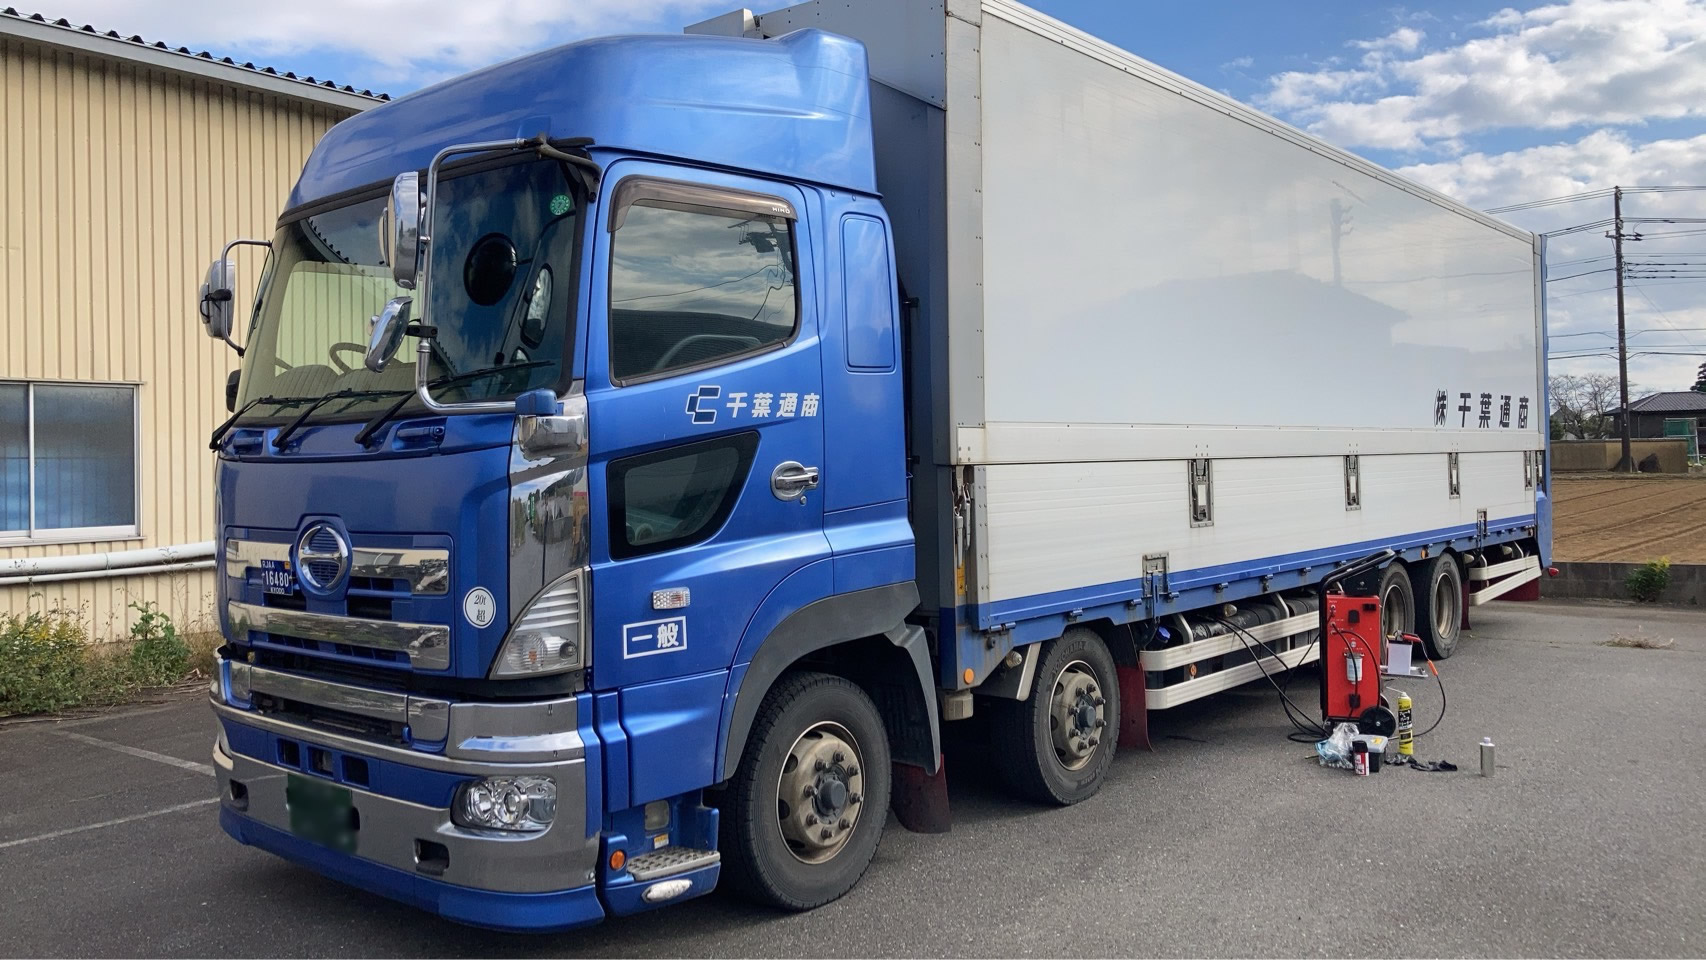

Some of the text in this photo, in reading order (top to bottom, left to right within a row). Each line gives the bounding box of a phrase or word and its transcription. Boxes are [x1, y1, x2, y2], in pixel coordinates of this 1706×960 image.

[726, 392, 820, 418] 千葉通商
[265, 570, 289, 587] 16480
[474, 594, 486, 606] 20t
[631, 622, 679, 649] 一般
